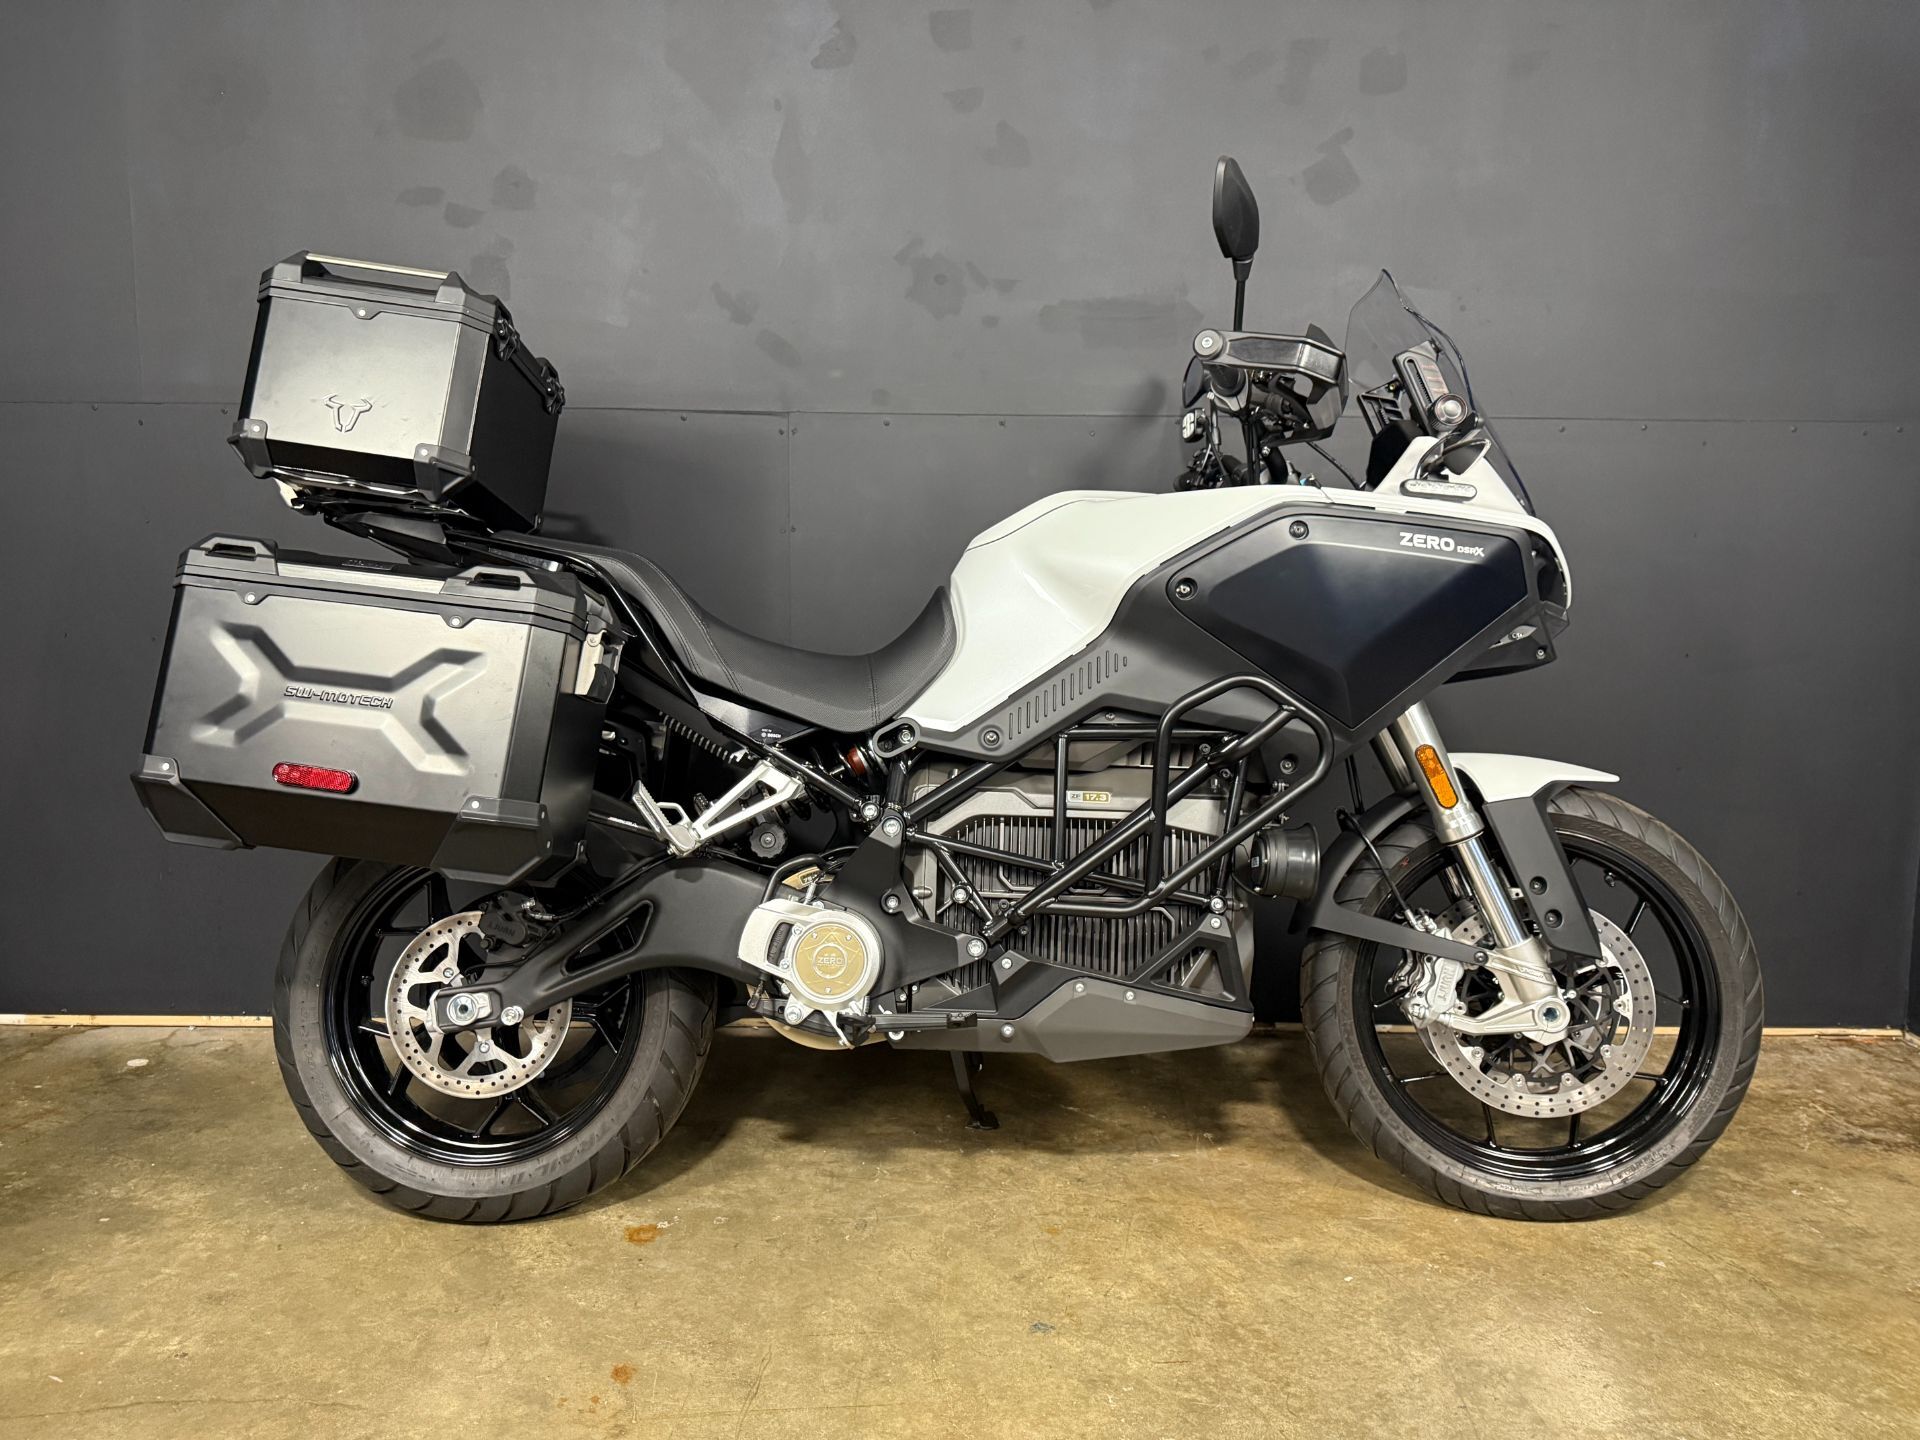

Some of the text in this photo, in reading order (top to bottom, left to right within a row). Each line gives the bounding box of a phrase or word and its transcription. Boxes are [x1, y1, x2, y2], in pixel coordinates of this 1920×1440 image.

[1399, 531, 1455, 552] ZERO
[283, 685, 393, 709] SW-MOTECH
[1084, 793, 1107, 802] 17.3
[817, 956, 844, 966] ZERO
